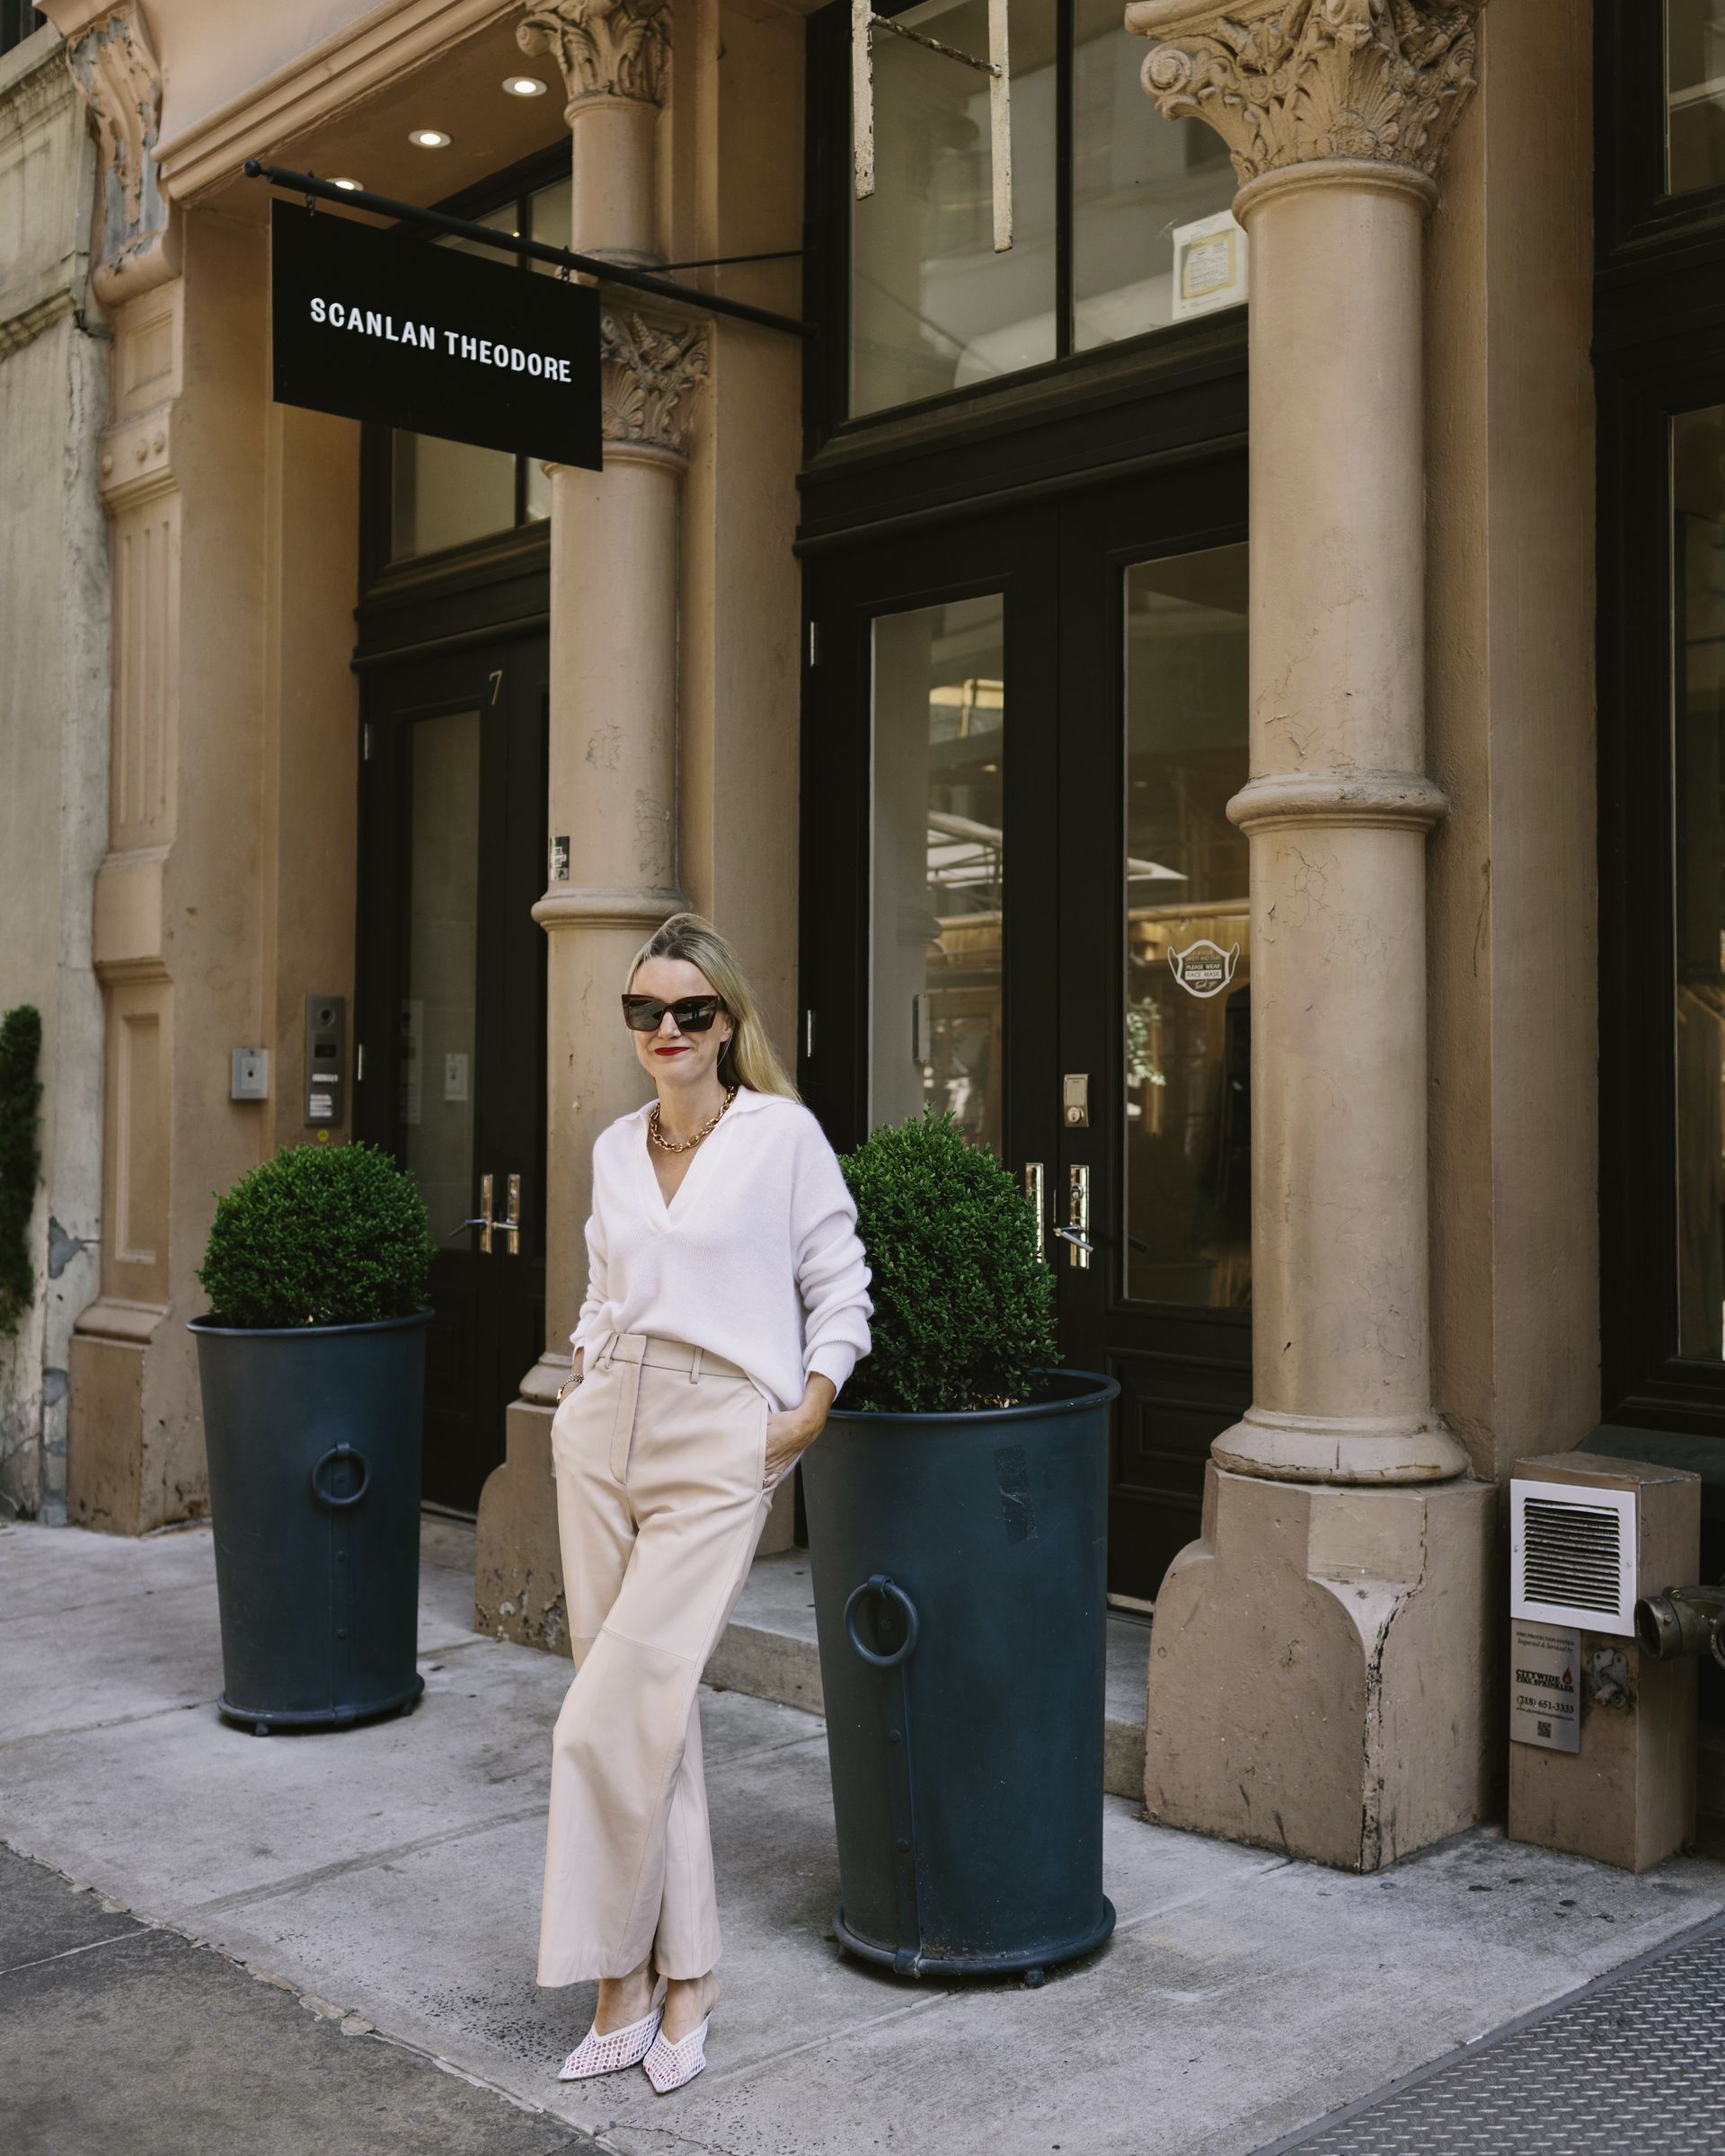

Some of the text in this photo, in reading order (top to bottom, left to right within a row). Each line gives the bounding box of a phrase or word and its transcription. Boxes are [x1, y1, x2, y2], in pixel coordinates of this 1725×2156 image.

[310, 297, 571, 383] SCANLAN THEODORE
[489, 669, 503, 705] 7
[1517, 1669, 1561, 1684] CITYWIDE
[1517, 1675, 1532, 1684] FIRE
[1517, 1695, 1574, 1714] (718) 651-3333
